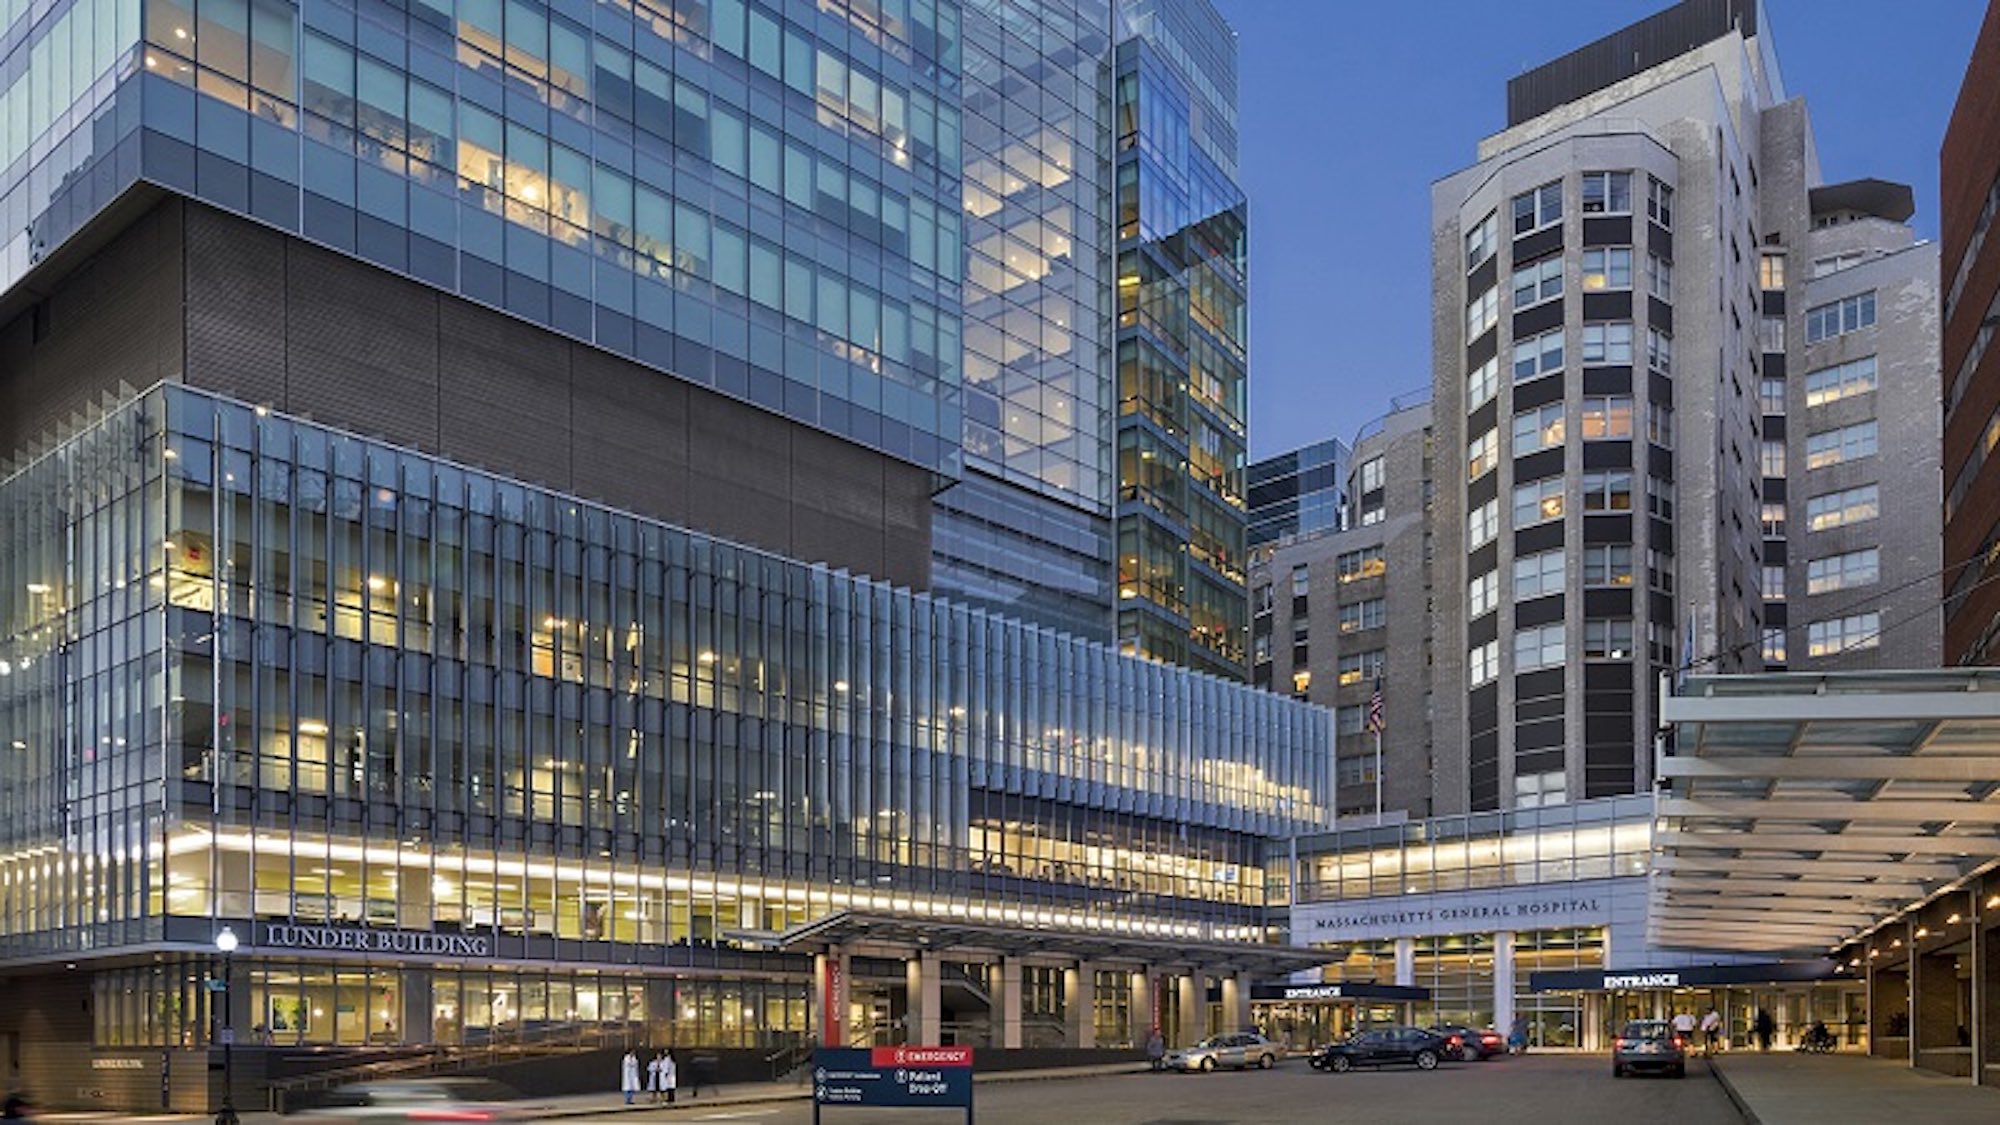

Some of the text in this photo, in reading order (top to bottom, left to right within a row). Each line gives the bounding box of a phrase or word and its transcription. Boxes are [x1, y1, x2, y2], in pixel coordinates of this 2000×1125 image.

[1315, 899, 1600, 929] MASSACHUSETTS GENERAL HOSPITAL
[266, 924, 488, 956] LUNDER BUILDING
[1603, 973, 1679, 989] ENTRANCE
[1284, 985, 1342, 999] ENTRANCE
[908, 1051, 967, 1062] EMERGENCY
[908, 1071, 942, 1082] Patient
